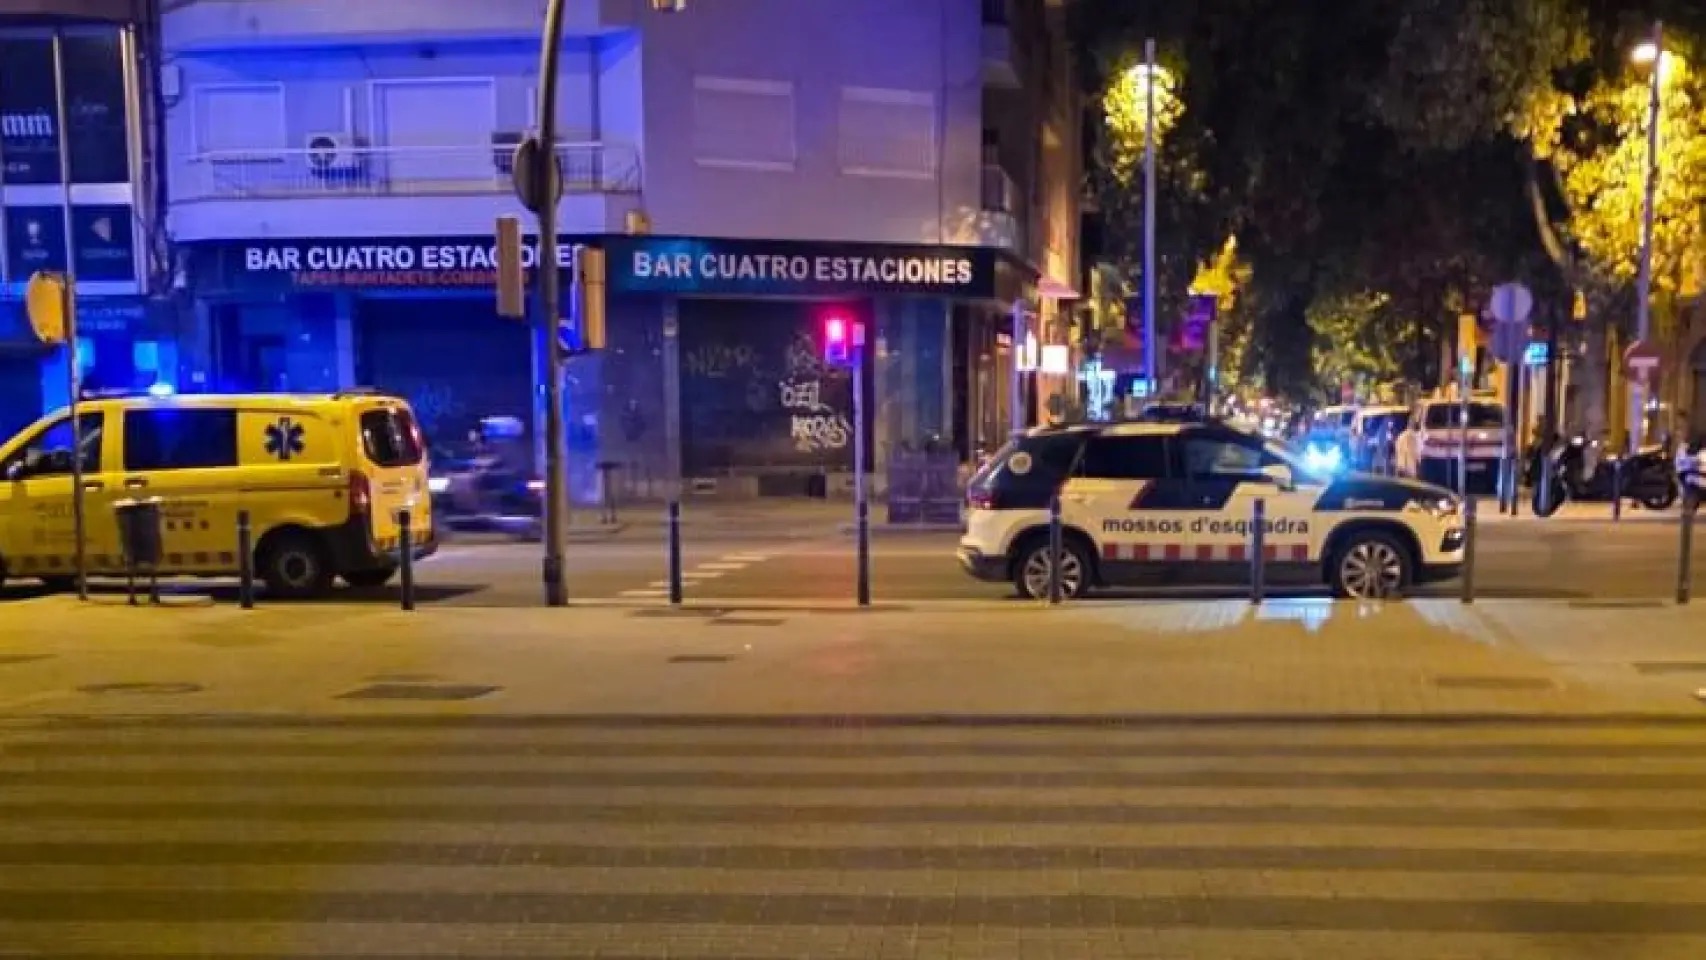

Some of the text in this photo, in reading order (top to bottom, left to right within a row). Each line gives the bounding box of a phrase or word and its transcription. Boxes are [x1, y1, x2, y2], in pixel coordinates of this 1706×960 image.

[245, 244, 586, 271] BAR CUATRO ESTACOE
[633, 251, 972, 284] BAR CUATRO ESTACIONES
[1103, 516, 1309, 537] mossos d'esqadra
